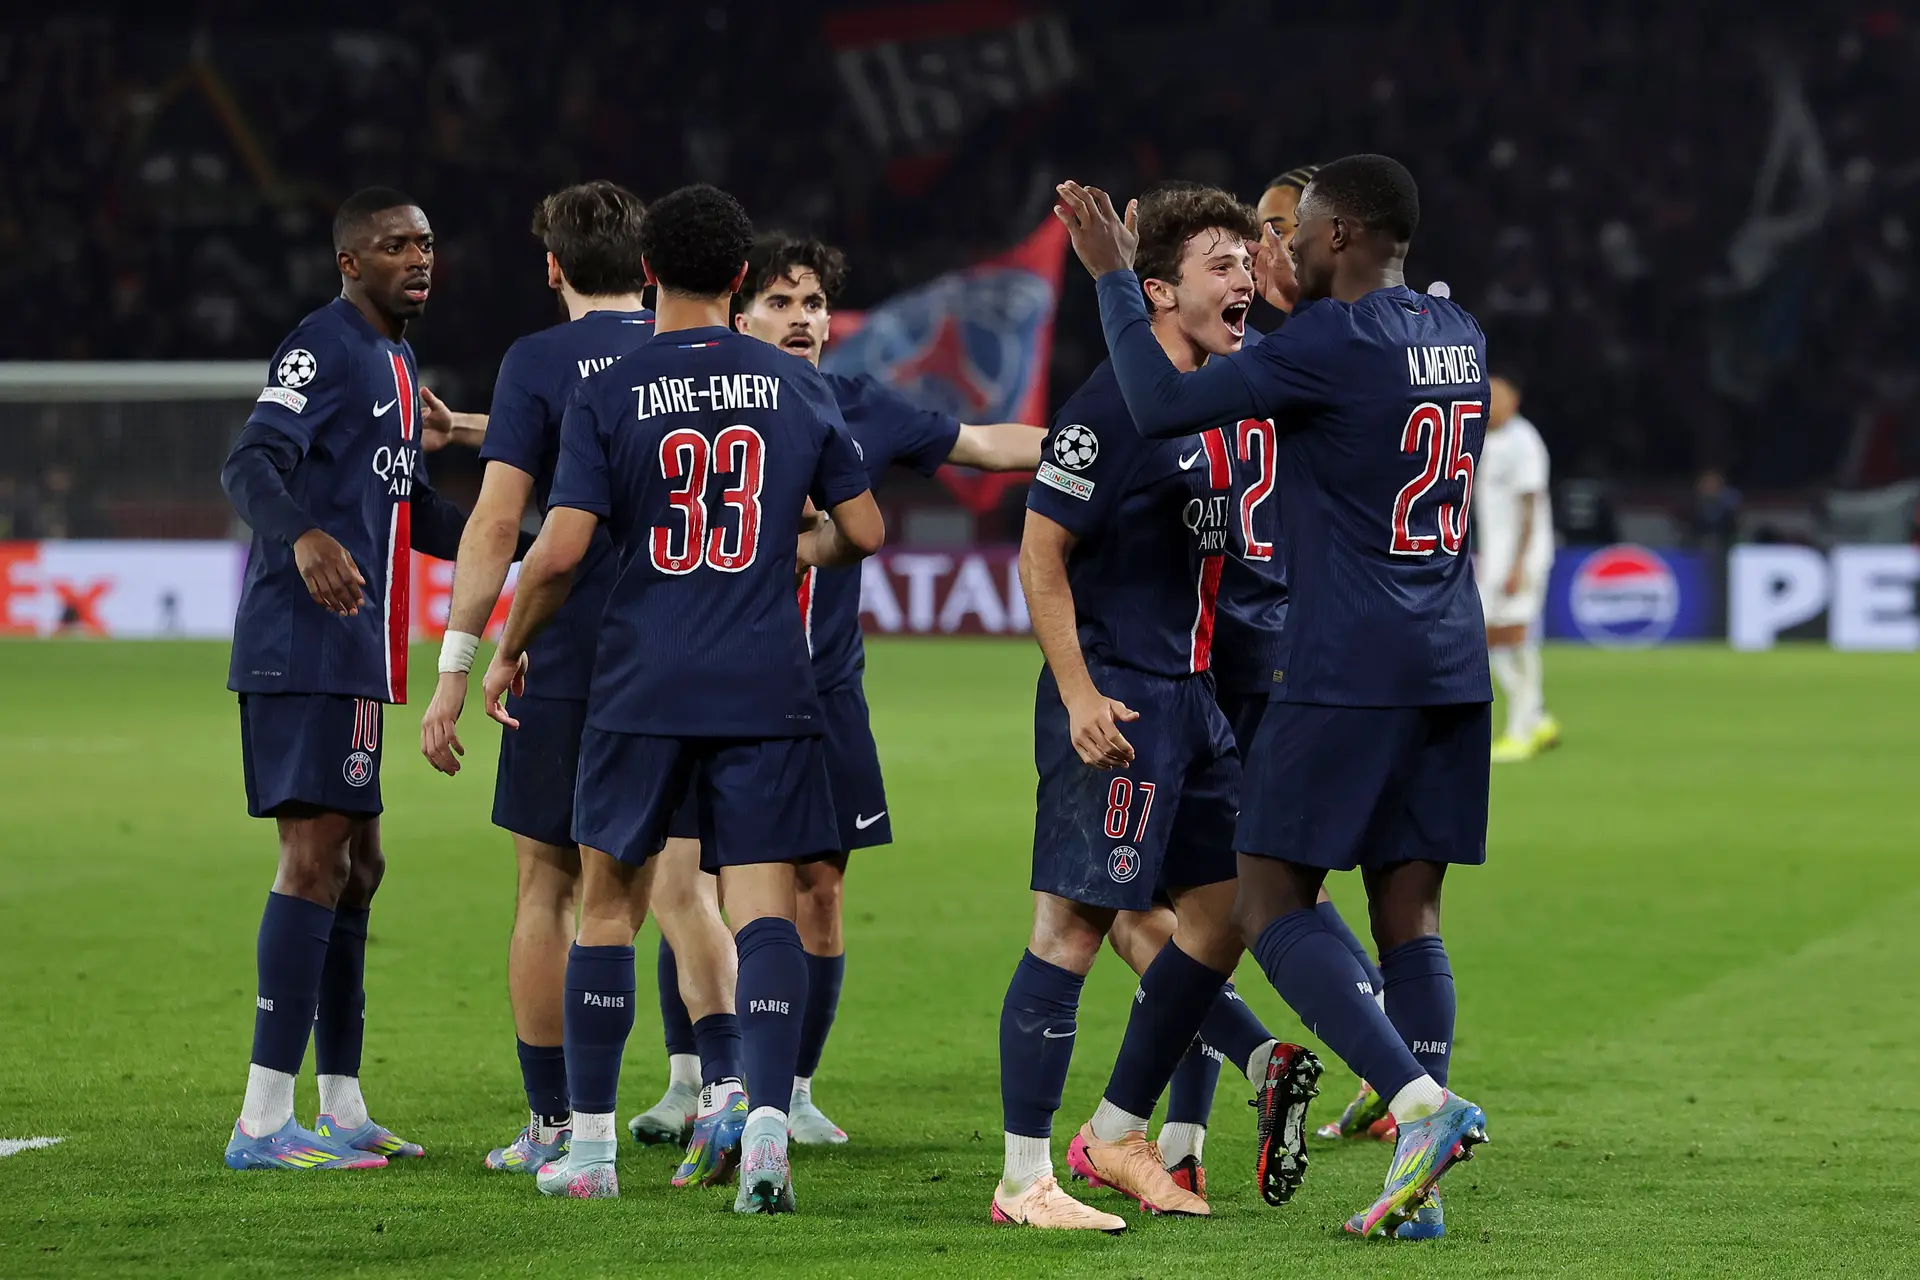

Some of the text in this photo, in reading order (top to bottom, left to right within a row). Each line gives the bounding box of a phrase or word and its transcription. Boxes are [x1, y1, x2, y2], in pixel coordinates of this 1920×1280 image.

[1407, 346, 1481, 385] N.MENDES
[632, 374, 780, 421] ZAÏRE-EMERY
[1040, 467, 1092, 495] FOUNDATION
[1390, 401, 1483, 555] 25
[650, 425, 766, 575] 33
[1727, 545, 1920, 652] PE
[351, 698, 379, 752] 10
[1104, 776, 1156, 842] 87
[1113, 847, 1136, 858] PARIS
[583, 991, 625, 1009] PARIS
[750, 999, 790, 1015] PARIS
[1412, 1040, 1448, 1055] PARIS
